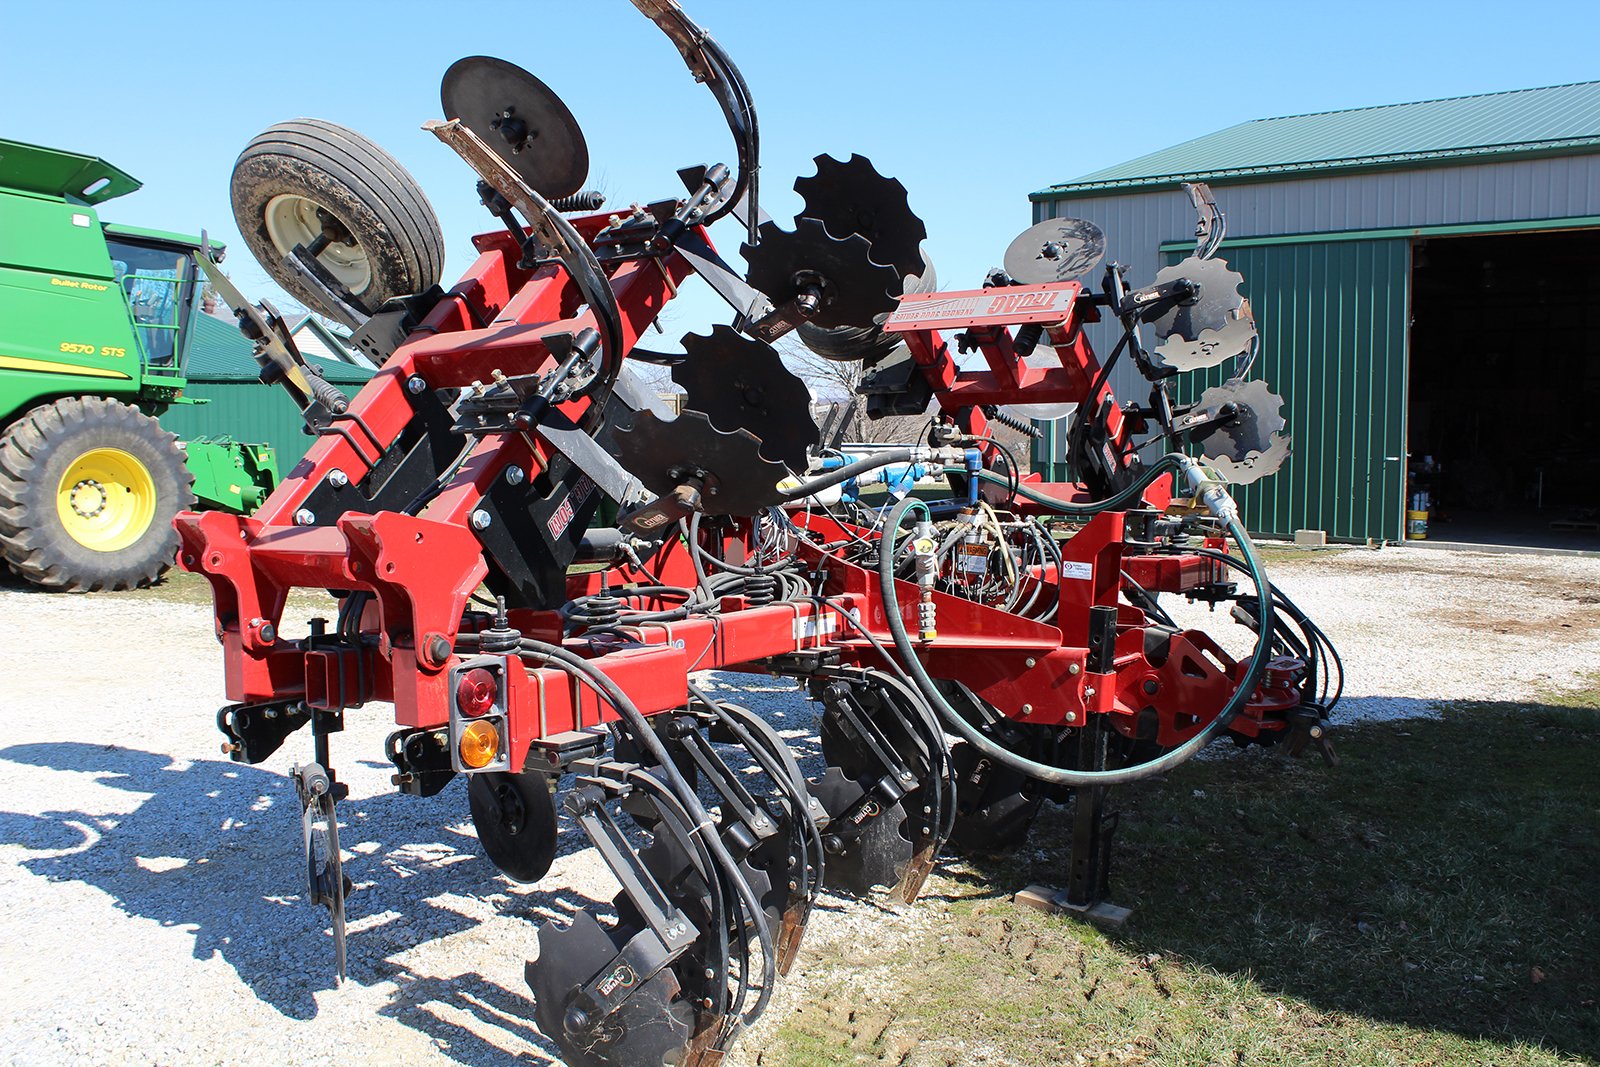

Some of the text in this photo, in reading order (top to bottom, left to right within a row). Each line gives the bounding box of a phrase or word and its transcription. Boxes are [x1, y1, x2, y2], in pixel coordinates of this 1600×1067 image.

[50, 277, 108, 292] Bullet Rotor
[60, 342, 126, 358] 9570 STS
[854, 806, 872, 824] CLYMER
[601, 970, 625, 996] CLYMER
